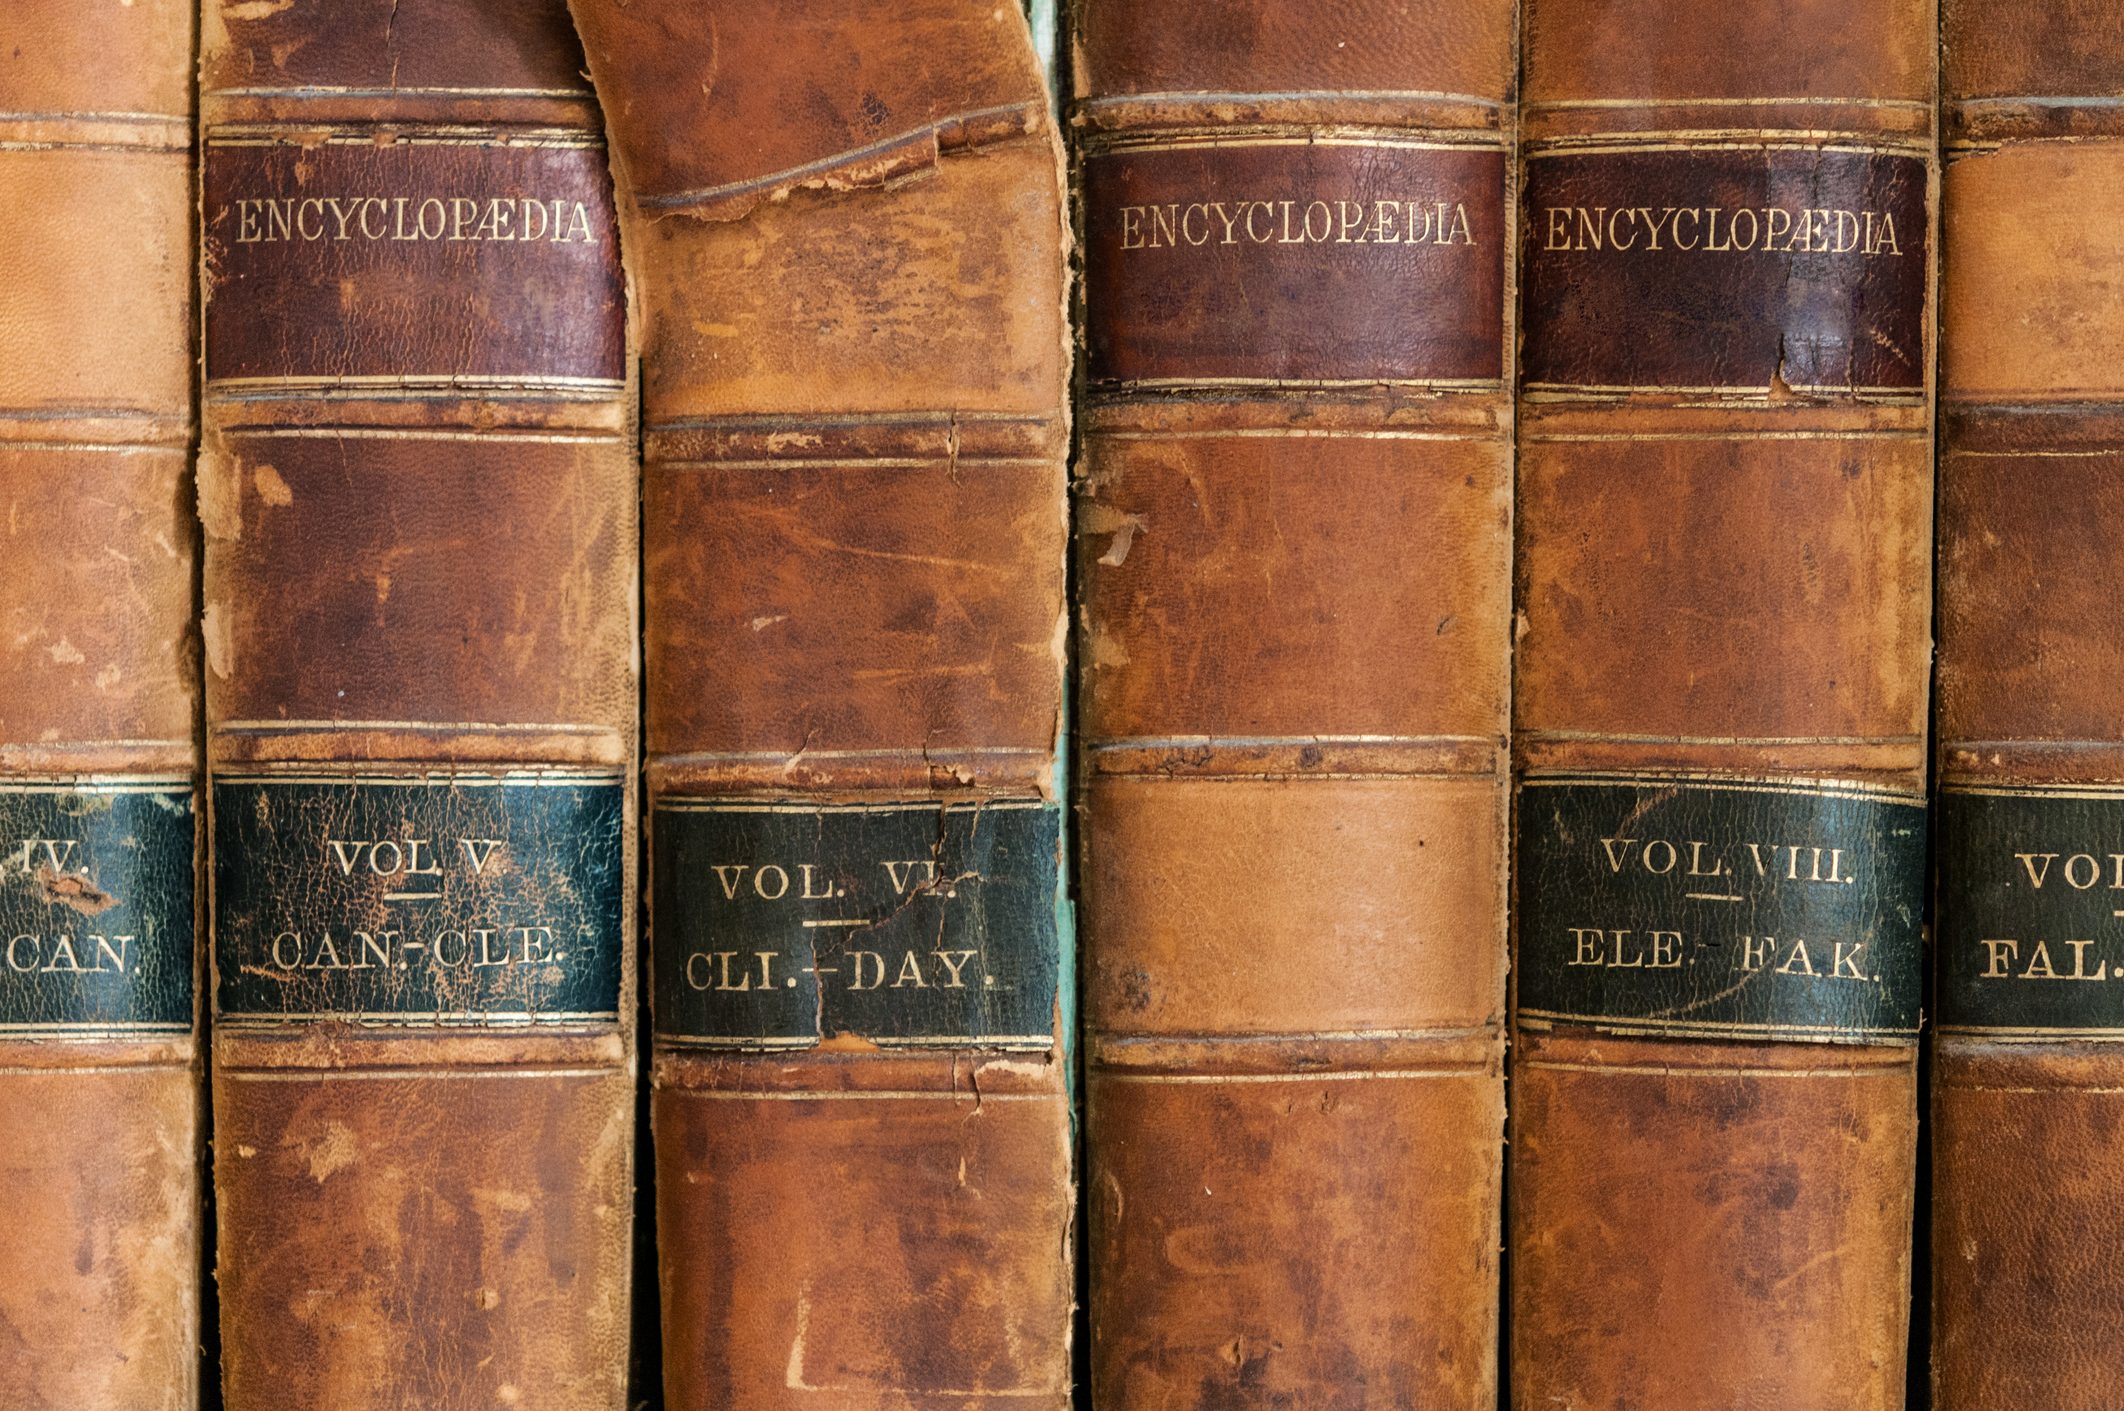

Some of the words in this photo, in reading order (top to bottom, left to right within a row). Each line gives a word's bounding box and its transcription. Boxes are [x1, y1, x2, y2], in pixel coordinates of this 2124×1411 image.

[235, 198, 598, 244] ENCYCLOPÆDIA
[1119, 200, 1477, 250] ENCYCLOPÆDIA
[1543, 206, 1903, 256] ENCYCLOPÆDIA
[17, 838, 89, 872] IV.
[328, 839, 444, 877] VOL.
[462, 839, 508, 875] V.
[1601, 838, 1732, 877] VOL.
[1748, 843, 1855, 884] VIII.
[711, 864, 845, 900] VOL.
[879, 861, 957, 898] VI.
[7, 934, 140, 973] CAN.
[1979, 940, 2124, 981] FAL.
